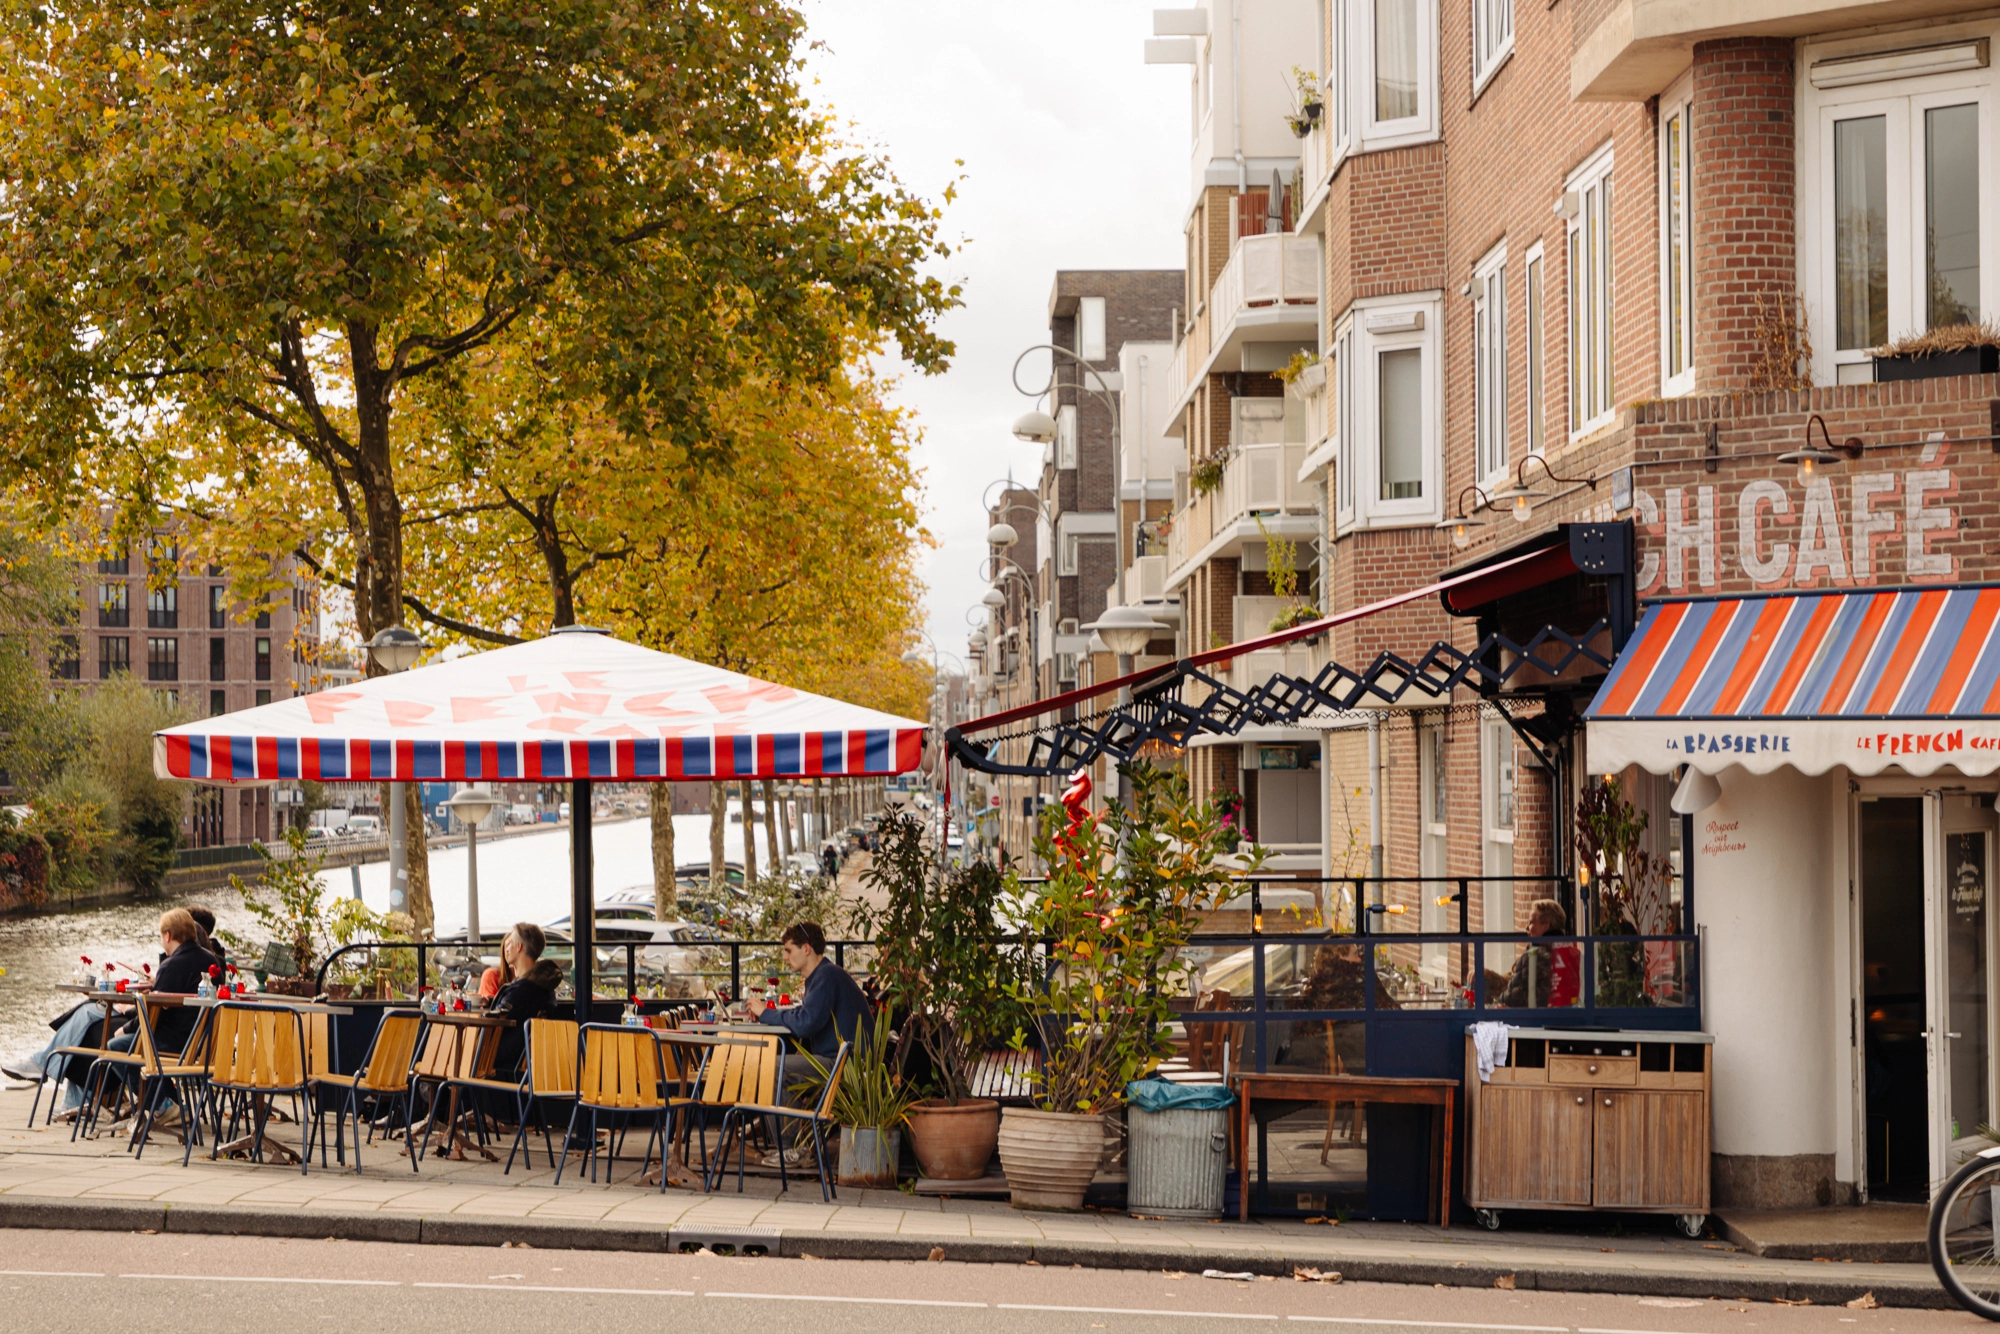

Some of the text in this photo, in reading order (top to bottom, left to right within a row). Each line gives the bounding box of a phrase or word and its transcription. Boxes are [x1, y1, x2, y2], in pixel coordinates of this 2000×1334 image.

[1739, 432, 1955, 584] CAFÉ
[507, 671, 614, 693] LE
[304, 677, 799, 727] FRENCH
[1666, 733, 1791, 753] LA BRASSERIE
[1857, 737, 1872, 748] LE
[1877, 728, 1963, 755] FRENCH
[1706, 820, 1739, 834] Respect
[1714, 834, 1727, 842] our
[1702, 841, 1746, 857] Neighbours
